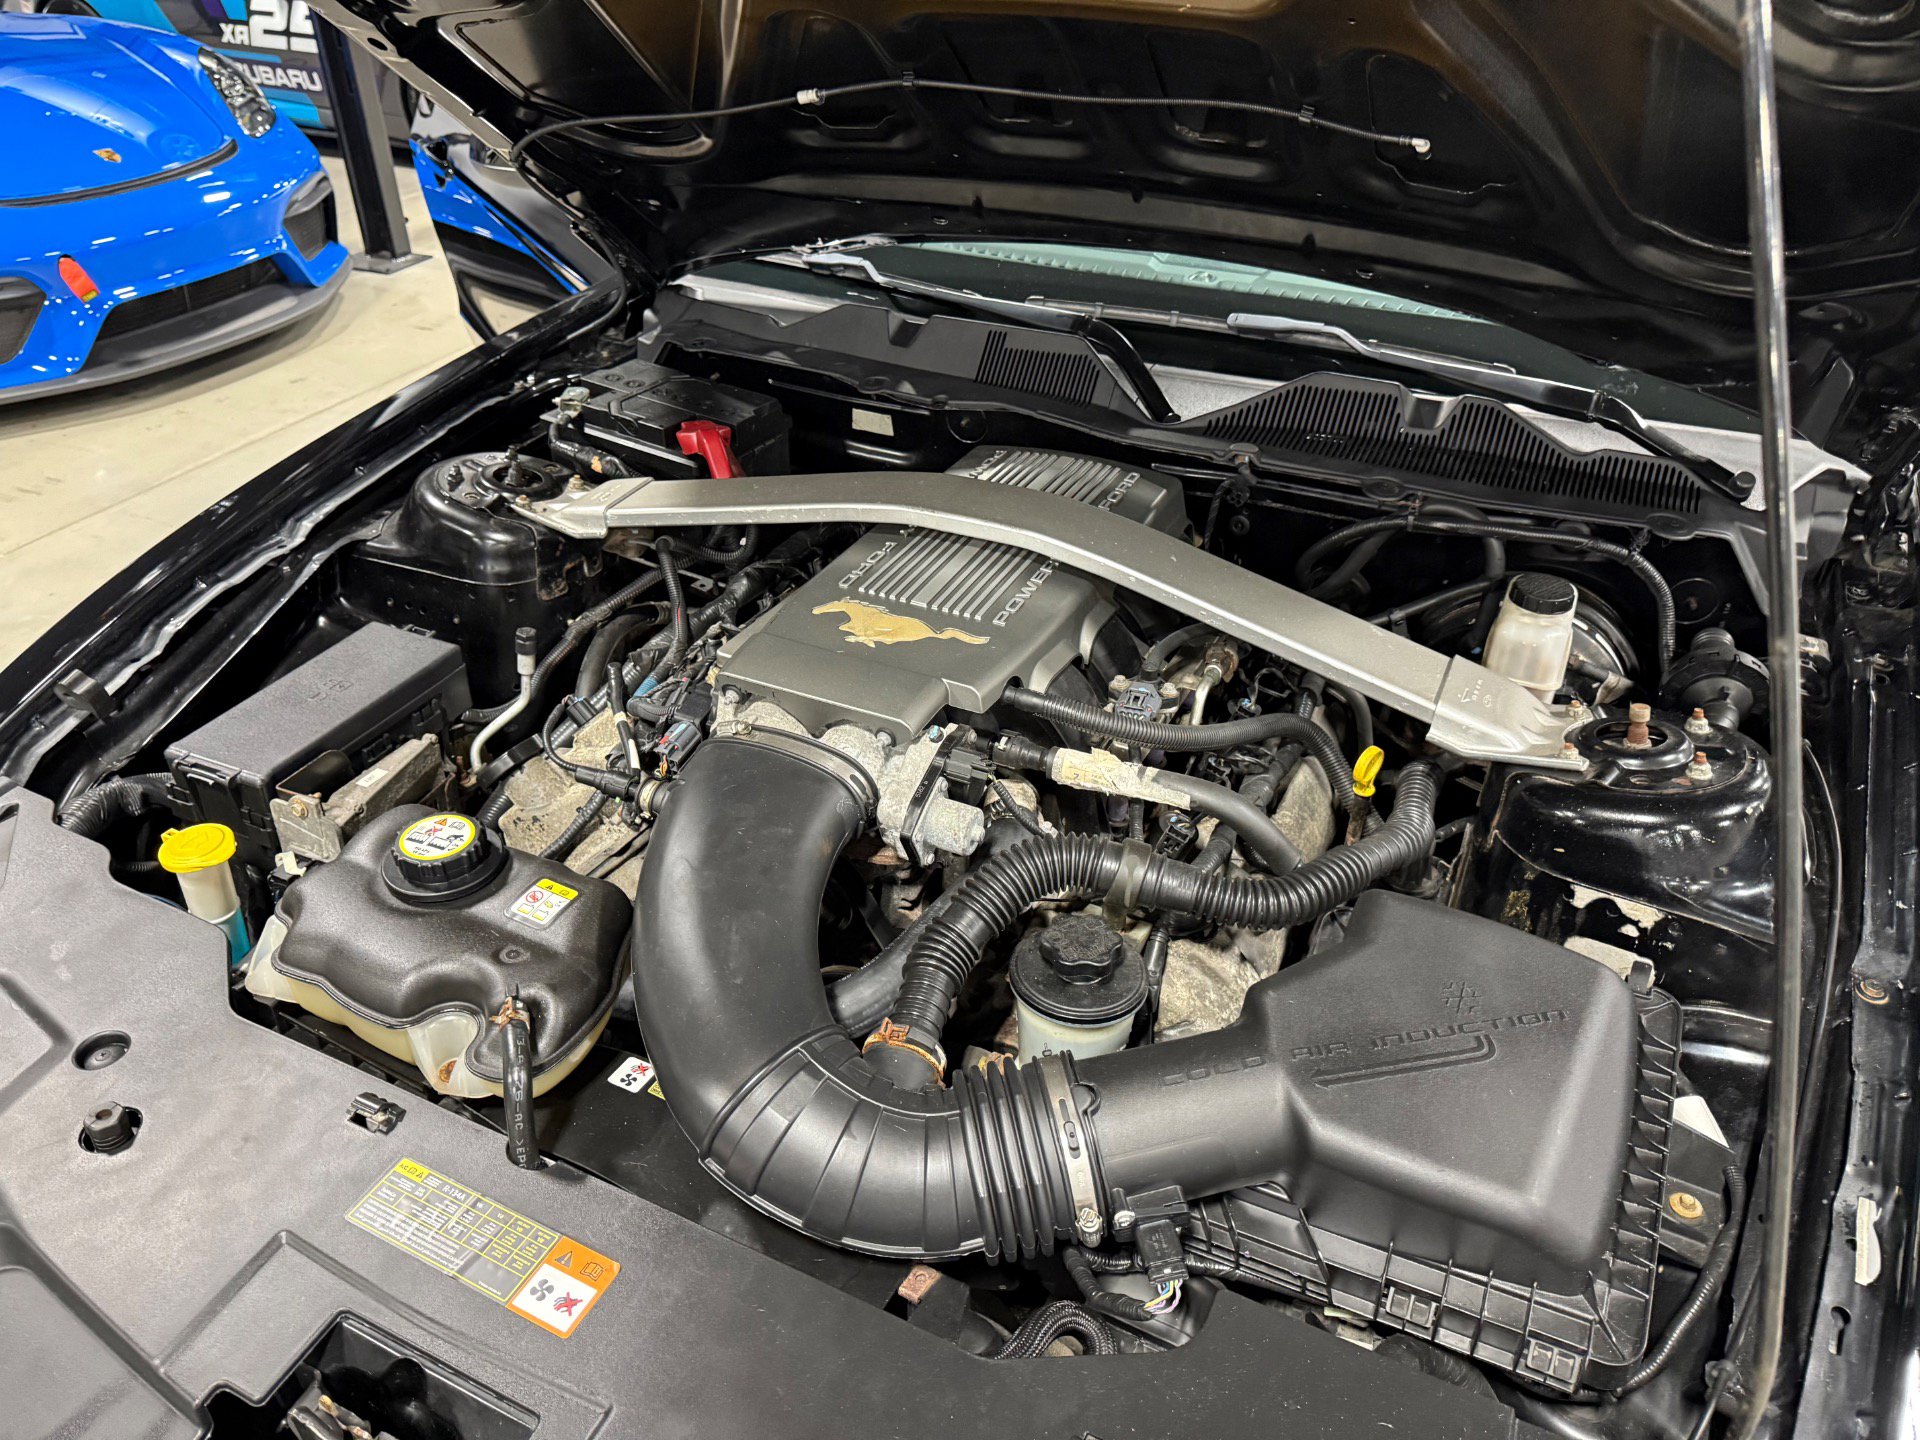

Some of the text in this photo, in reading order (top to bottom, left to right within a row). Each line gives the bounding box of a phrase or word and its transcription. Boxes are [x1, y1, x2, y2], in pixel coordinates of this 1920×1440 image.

[238, 62, 323, 92] UBARU
[1098, 472, 1140, 511] FORD
[838, 541, 898, 588] FORD
[1162, 1009, 1570, 1087] COLD AIR INDUCTION
[442, 1184, 466, 1201] R-134A
